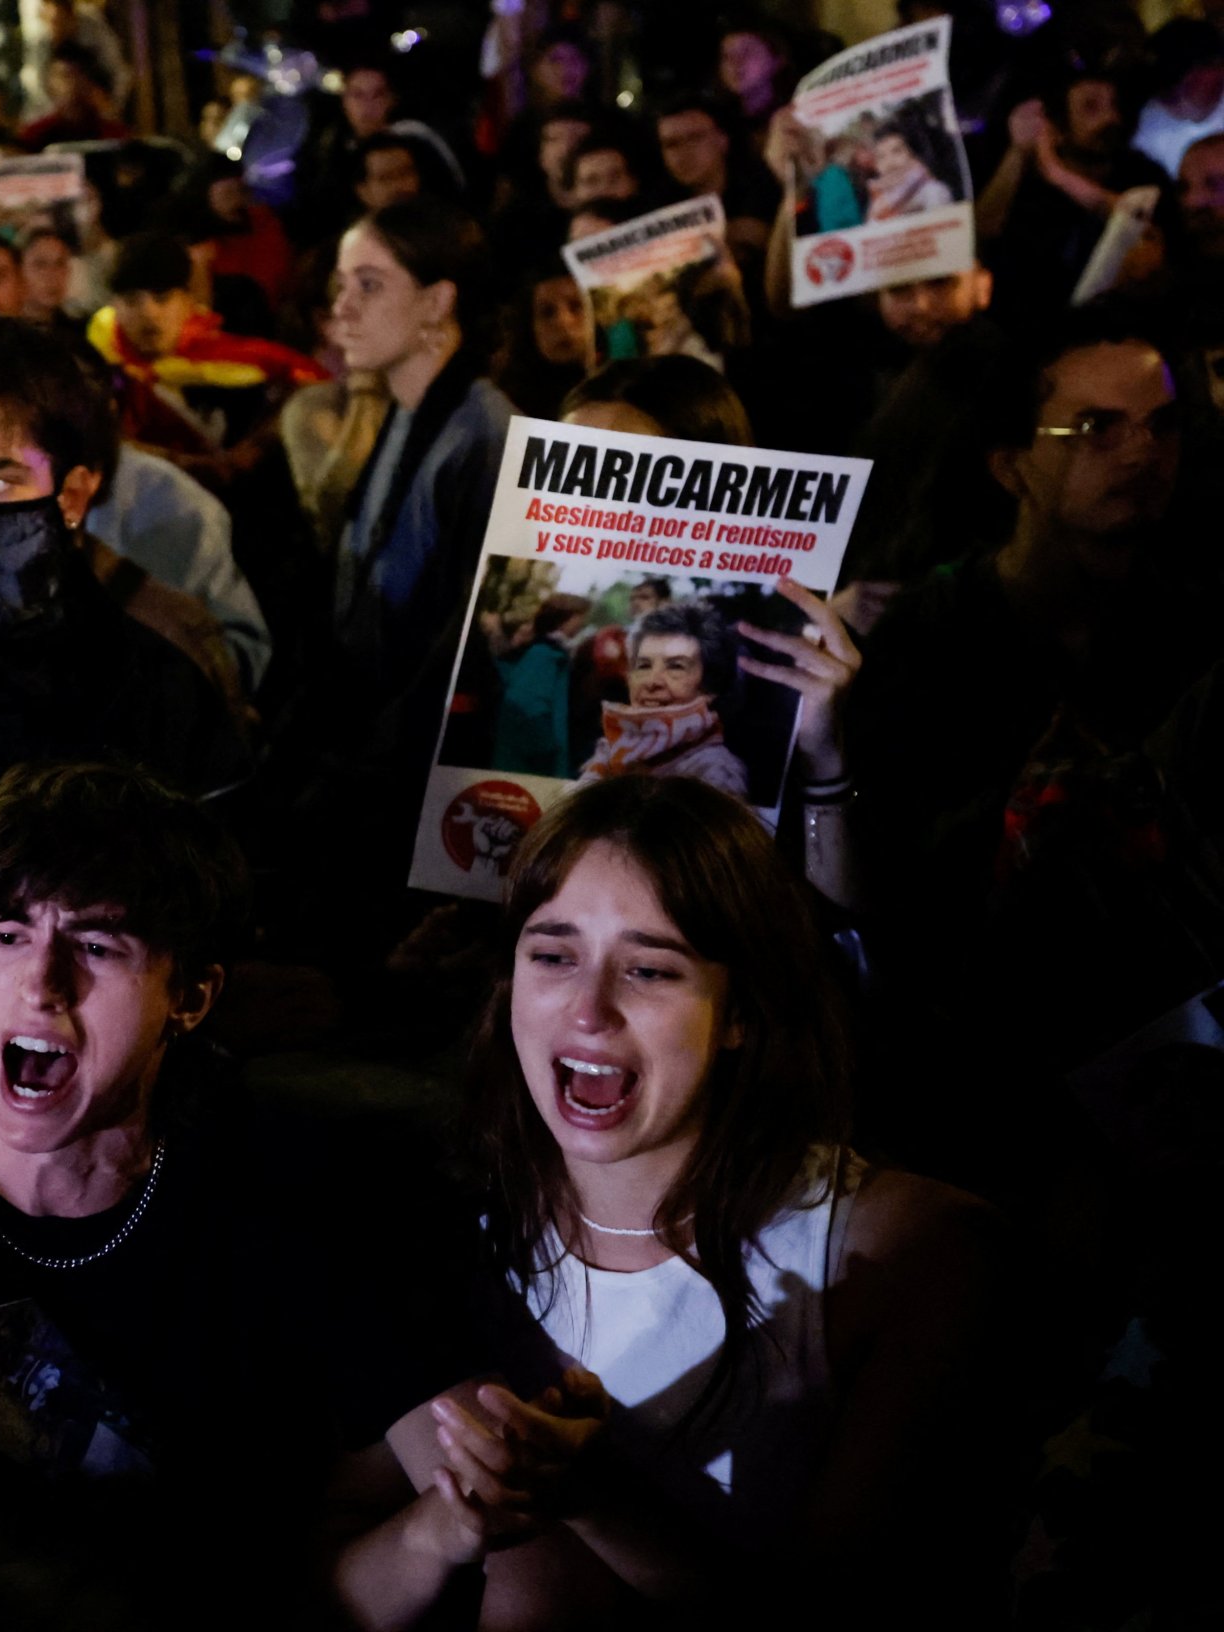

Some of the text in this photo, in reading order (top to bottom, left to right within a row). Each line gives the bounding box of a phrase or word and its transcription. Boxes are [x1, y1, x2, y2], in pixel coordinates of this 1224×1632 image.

[517, 437, 851, 524] MARICARMEN
[526, 498, 816, 552] Asesinada por el rentismo
[535, 530, 793, 577] y sus políticos a sueldo
